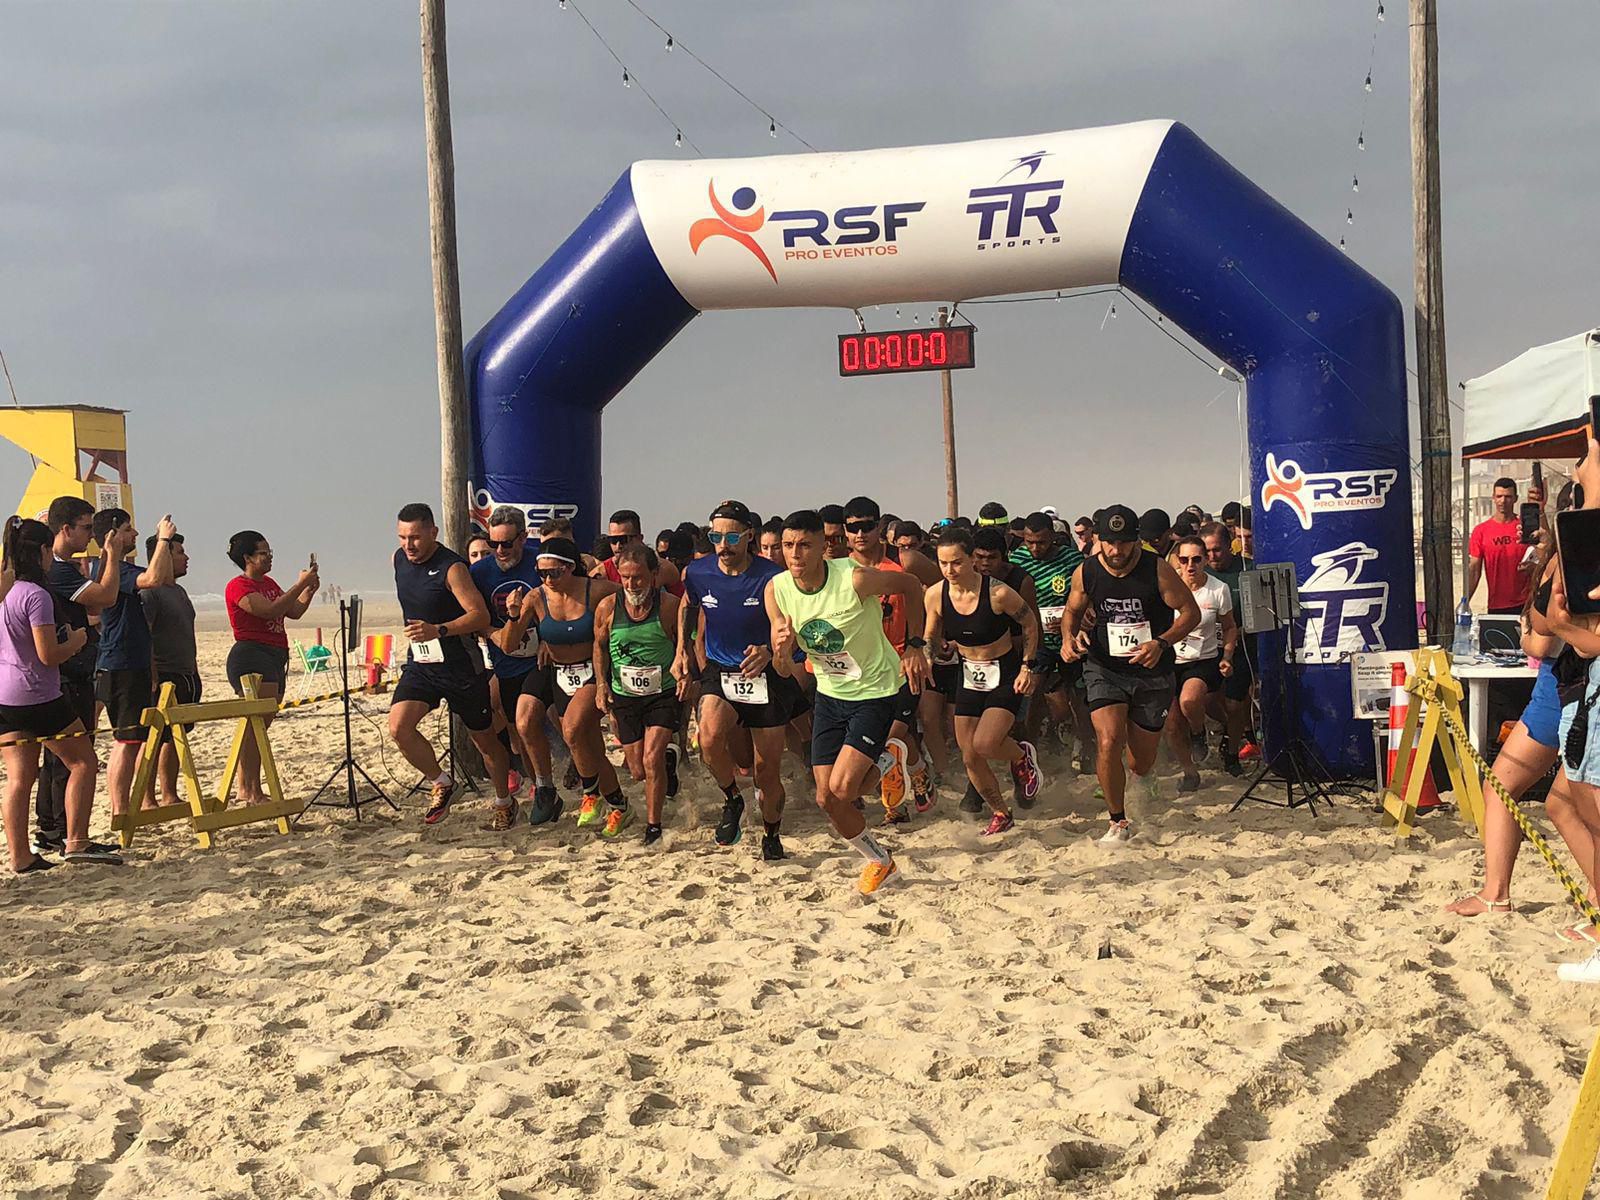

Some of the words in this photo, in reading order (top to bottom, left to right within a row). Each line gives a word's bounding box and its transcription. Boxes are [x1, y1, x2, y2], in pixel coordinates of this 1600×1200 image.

[966, 180, 1065, 241] TTR
[767, 201, 928, 248] RSF
[977, 236, 1061, 251] SPORTS
[785, 249, 819, 261] PRO
[823, 244, 899, 259] EVENTOS
[1304, 473, 1394, 500] RSF
[1314, 500, 1336, 508] PRO
[1338, 497, 1382, 507] EVENTOS
[527, 508, 576, 528] SF
[1118, 635, 1139, 647] 174
[418, 644, 430, 655] 111
[567, 675, 581, 687] 38
[630, 676, 650, 688] 106
[972, 671, 987, 682] 22
[733, 682, 754, 695] 132
